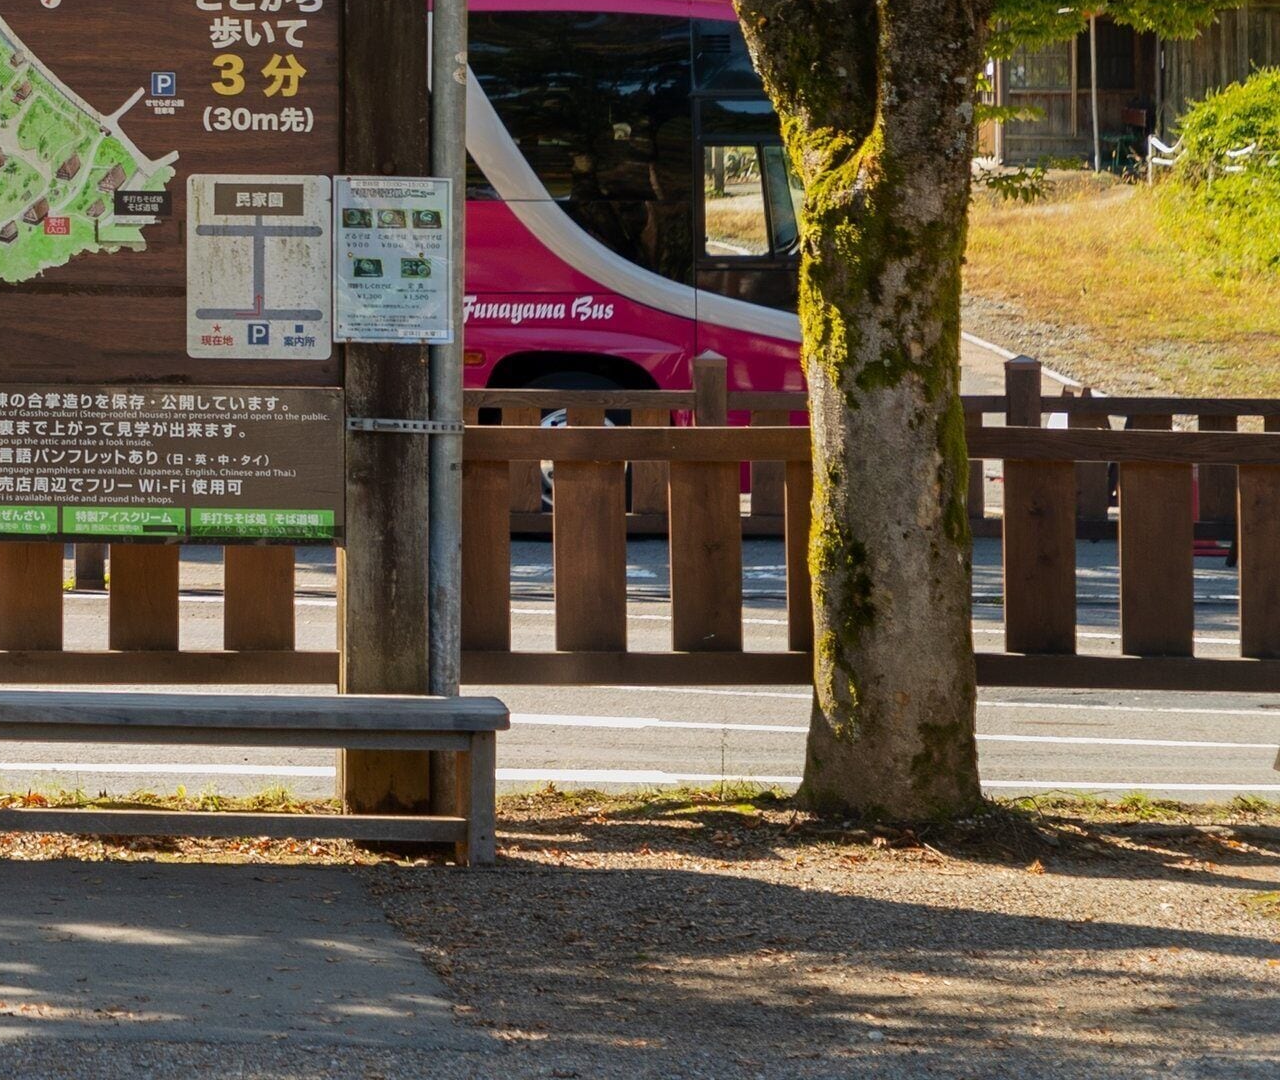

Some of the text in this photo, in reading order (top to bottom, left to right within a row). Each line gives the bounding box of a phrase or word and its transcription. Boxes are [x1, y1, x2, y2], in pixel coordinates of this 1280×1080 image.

[209, 16, 308, 49] 歩いて
[235, 192, 284, 208] 民家園
[463, 294, 614, 325] Funayama Bus
[201, 335, 233, 346] 現在地
[283, 336, 315, 347] 案内所
[9, 409, 18, 417] of
[19, 409, 77, 418] Gassho-zukuri
[80, 410, 137, 419] (Steep-roofed
[140, 411, 171, 420] houses)
[189, 411, 230, 421] preserved
[232, 411, 247, 419] and
[250, 413, 272, 421] open
[274, 412, 283, 420] to
[285, 412, 299, 420] the
[301, 412, 330, 421] public.
[24, 437, 38, 445] the
[40, 437, 58, 445] attic
[79, 438, 96, 446] take
[106, 438, 124, 446] look
[126, 438, 153, 446] inside.
[36, 465, 80, 475] pamphlets
[97, 466, 137, 475] available.
[140, 467, 183, 477] (Japanese,
[185, 468, 217, 477] English,
[219, 468, 253, 477] Chinese
[255, 469, 271, 477] and
[139, 479, 186, 493] Wi-Fi
[192, 479, 243, 495] 使用可
[15, 494, 51, 502] available
[53, 494, 78, 502] inside
[98, 495, 129, 503] around
[147, 495, 175, 504] shops.
[75, 510, 172, 523] 特製アイスクリーム
